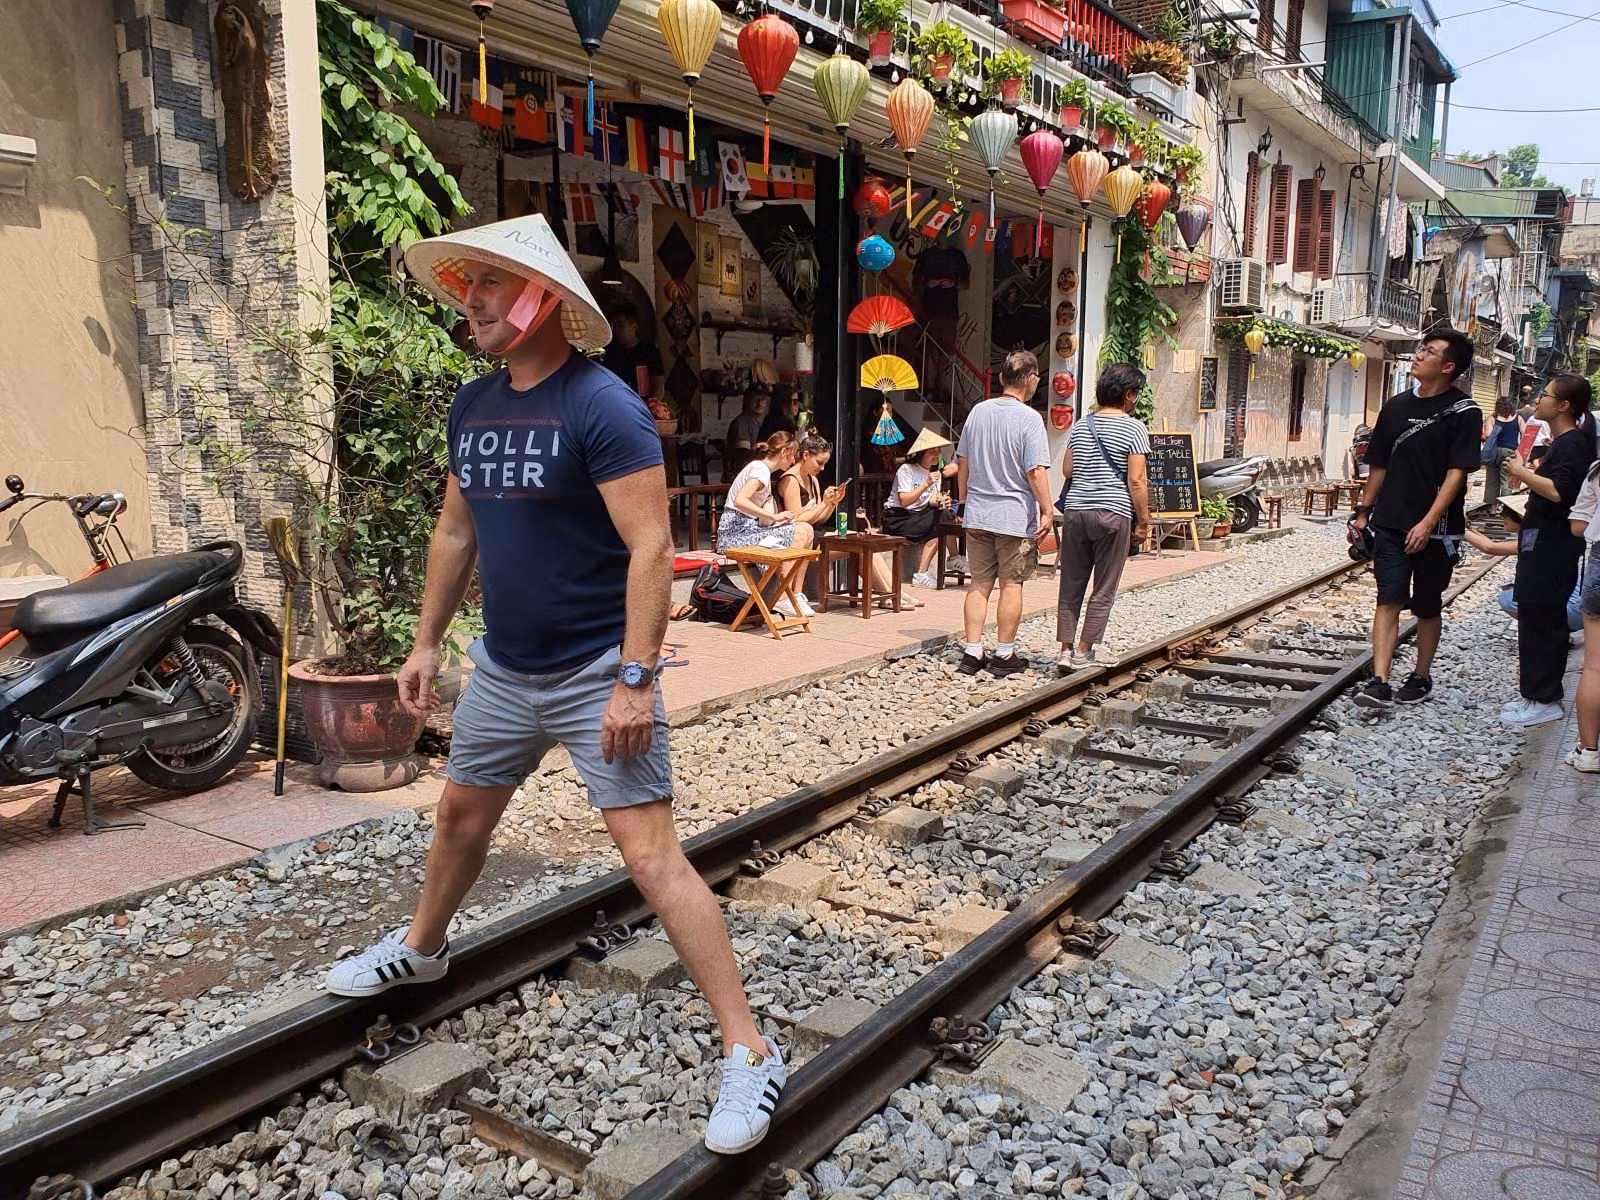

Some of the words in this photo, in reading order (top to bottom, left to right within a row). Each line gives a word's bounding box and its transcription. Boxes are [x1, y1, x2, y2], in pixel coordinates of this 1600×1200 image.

[458, 431, 560, 457] HOLLI
[1153, 436, 1166, 445] Red
[1167, 436, 1184, 445] Train
[1148, 449, 1165, 460] IME
[1166, 448, 1191, 459] TABLE
[459, 462, 545, 488] STER
